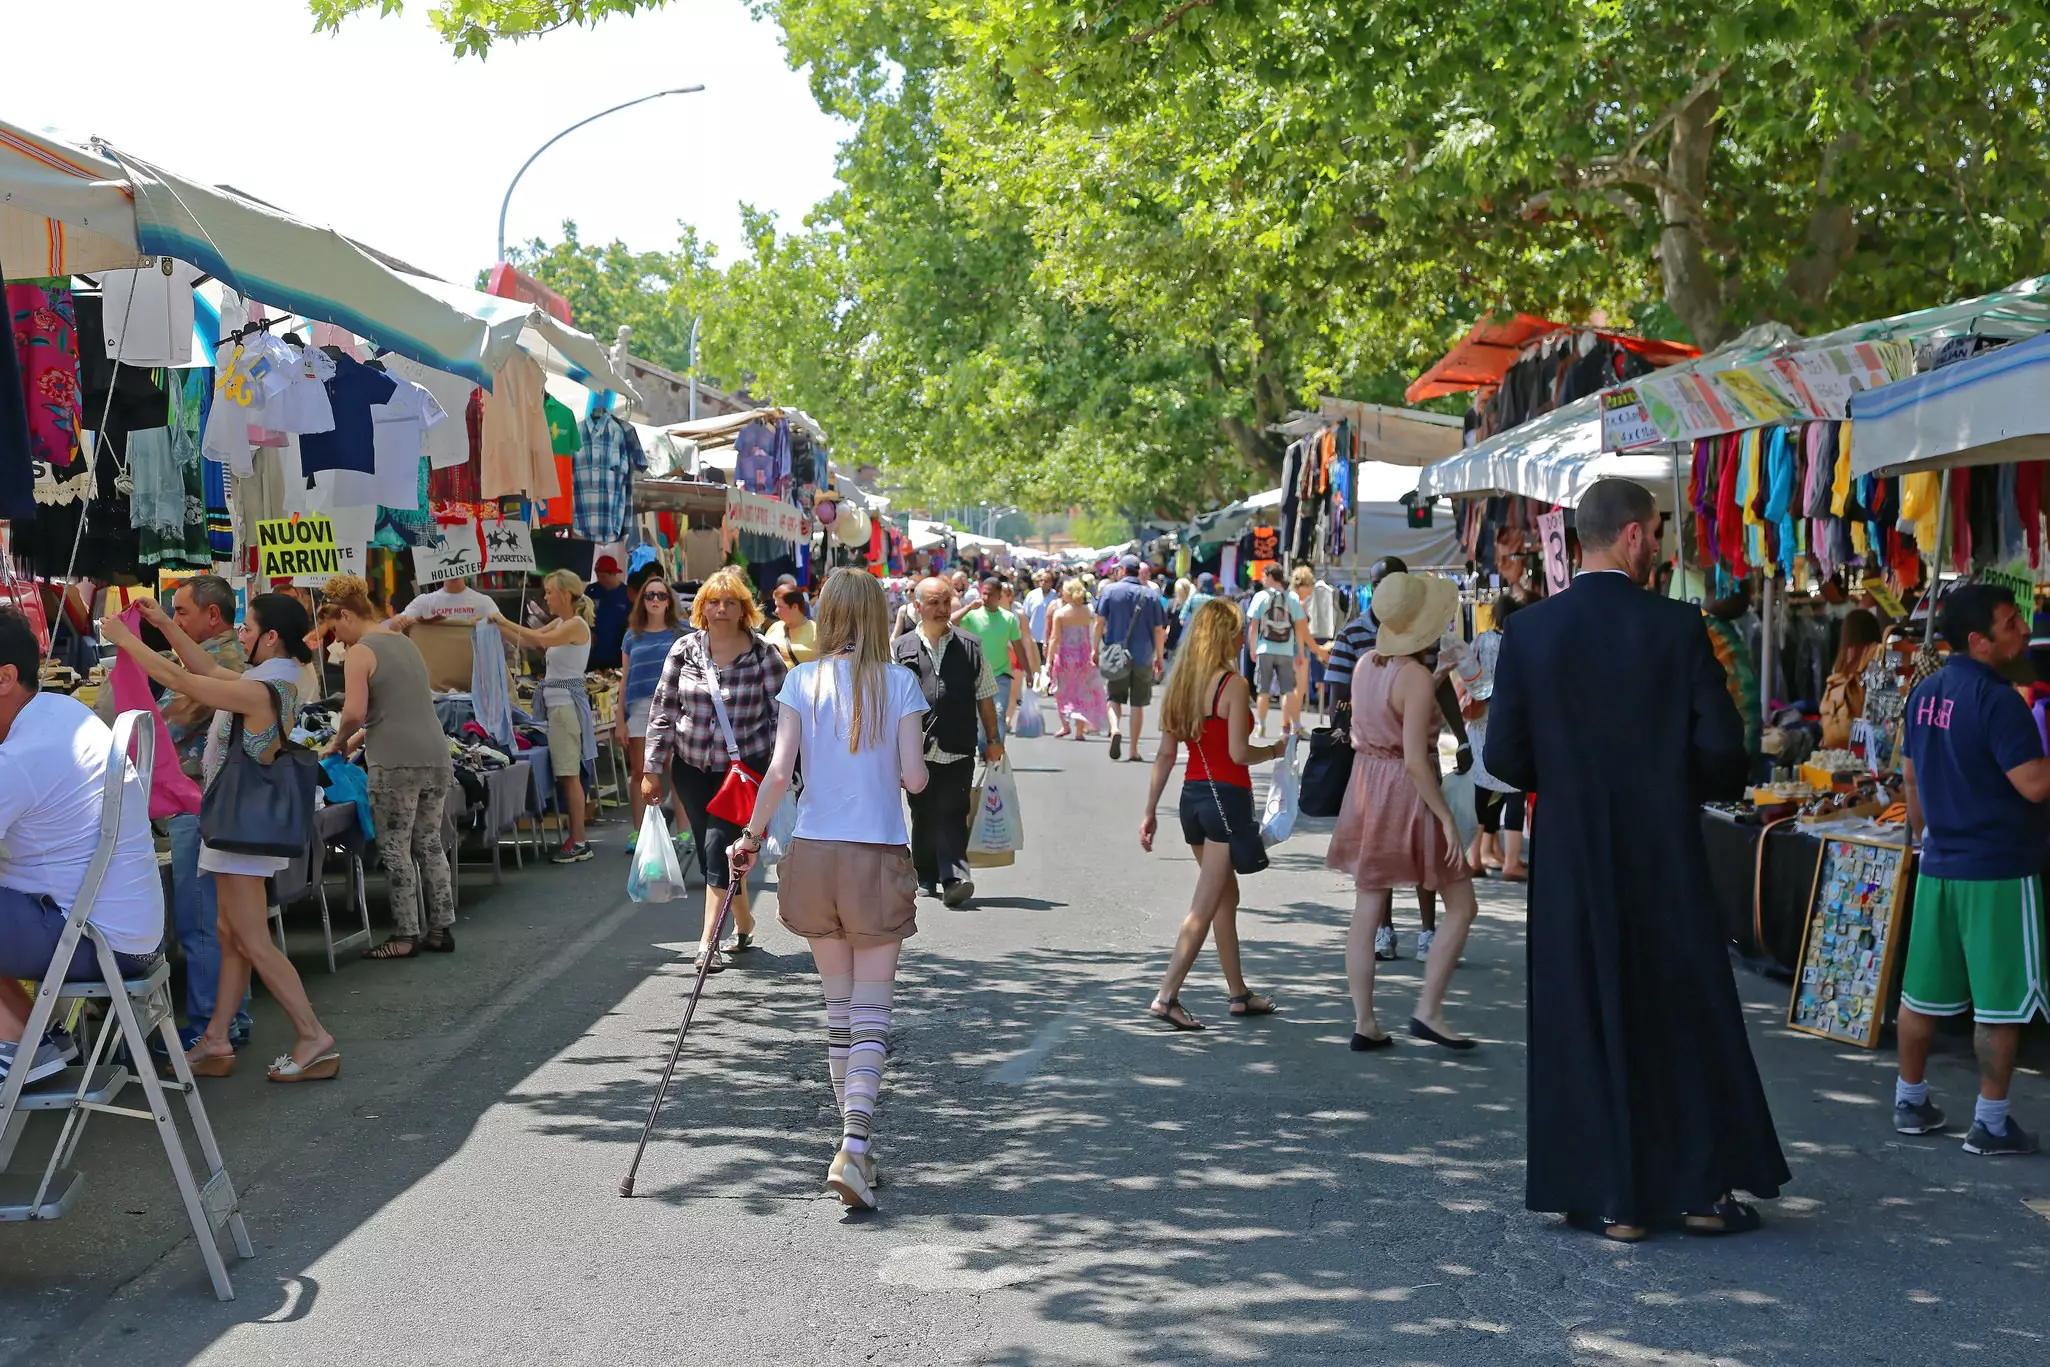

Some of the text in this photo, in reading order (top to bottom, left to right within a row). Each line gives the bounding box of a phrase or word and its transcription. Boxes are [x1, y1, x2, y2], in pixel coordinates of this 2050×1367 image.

[259, 521, 333, 546] NUOVI
[266, 549, 339, 575] ARRIVI
[1549, 531, 1565, 589] 3
